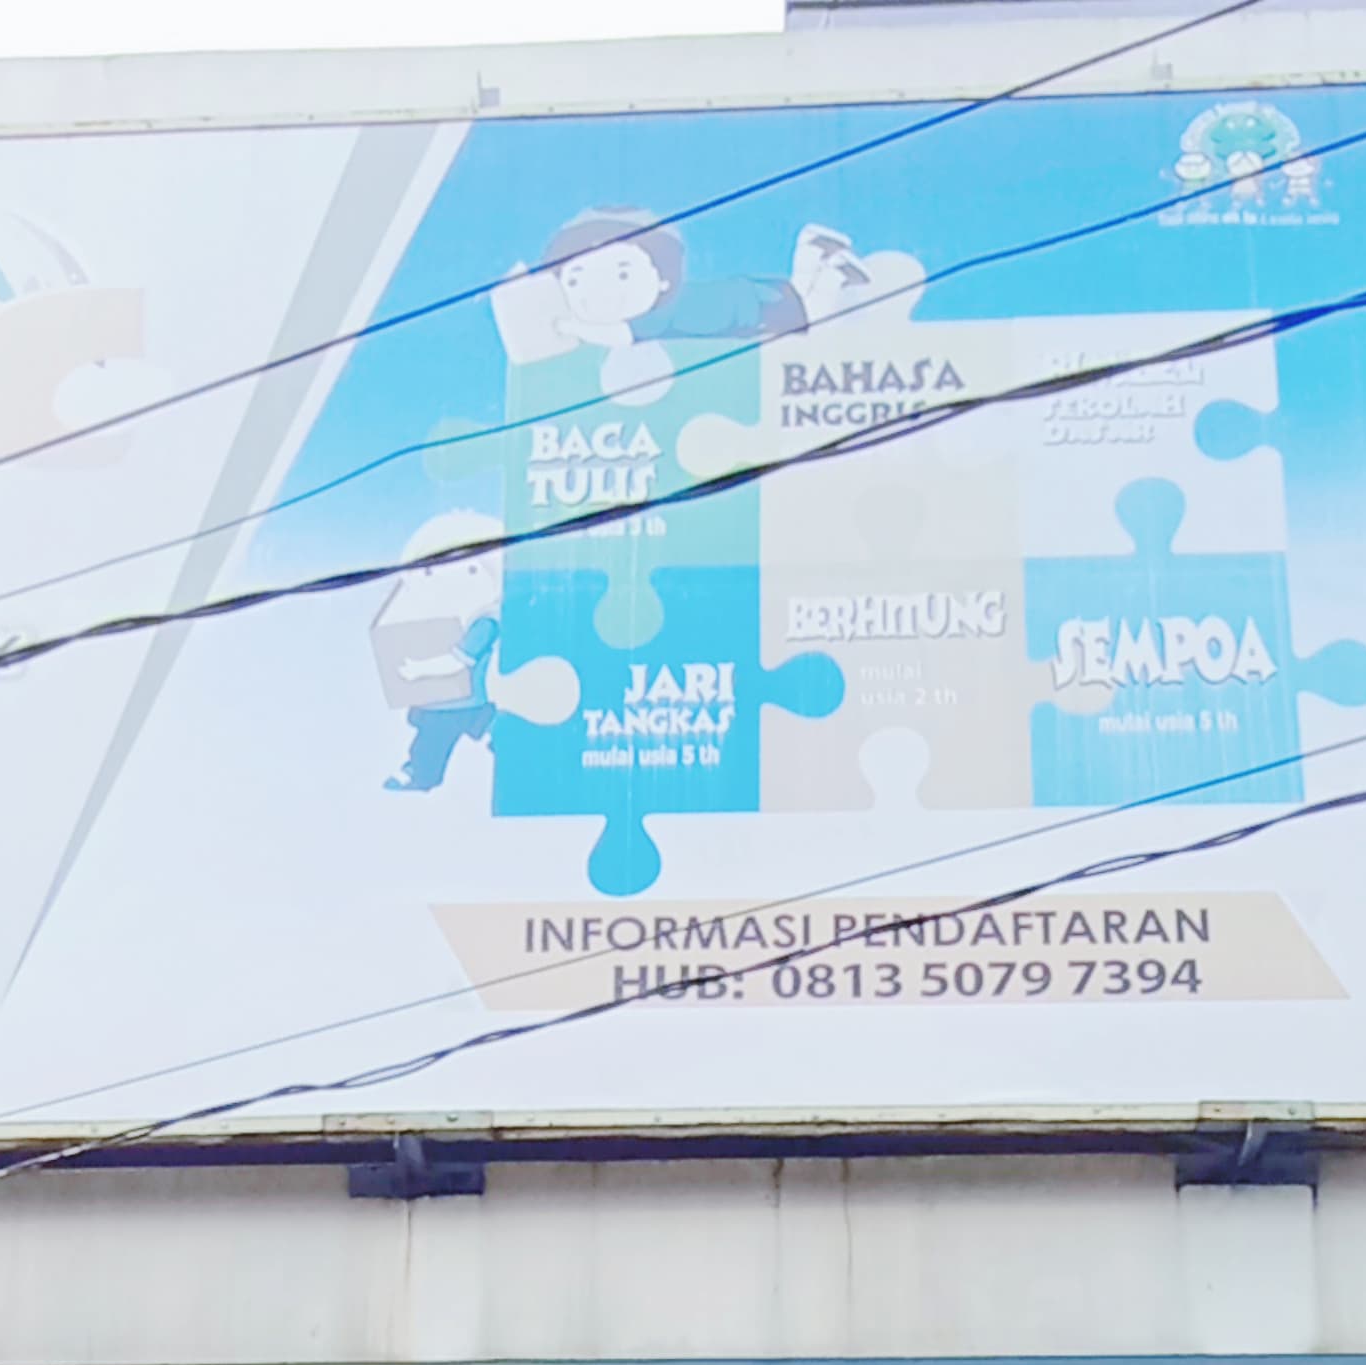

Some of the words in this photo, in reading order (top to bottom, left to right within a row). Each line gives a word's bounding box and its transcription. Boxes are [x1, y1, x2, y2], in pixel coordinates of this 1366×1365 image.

[780, 357, 967, 396] BAHASA
[530, 421, 663, 461] BACA
[526, 465, 657, 506] TULIS
[787, 590, 1008, 640] BERHITUNG
[1051, 614, 1278, 687] SEMPOA
[625, 662, 735, 704] JARI
[583, 704, 735, 735] TANGKAS
[582, 744, 634, 768] mulai
[639, 746, 677, 767] usia
[682, 745, 694, 764] 5
[699, 744, 721, 766] th
[526, 914, 810, 952] INFORMASI
[835, 908, 1210, 947] PENDAFTARAN
[614, 965, 744, 1000] HUB:
[772, 961, 901, 999] 0813
[920, 960, 1052, 997] 5079
[1068, 959, 1202, 995] 7394
